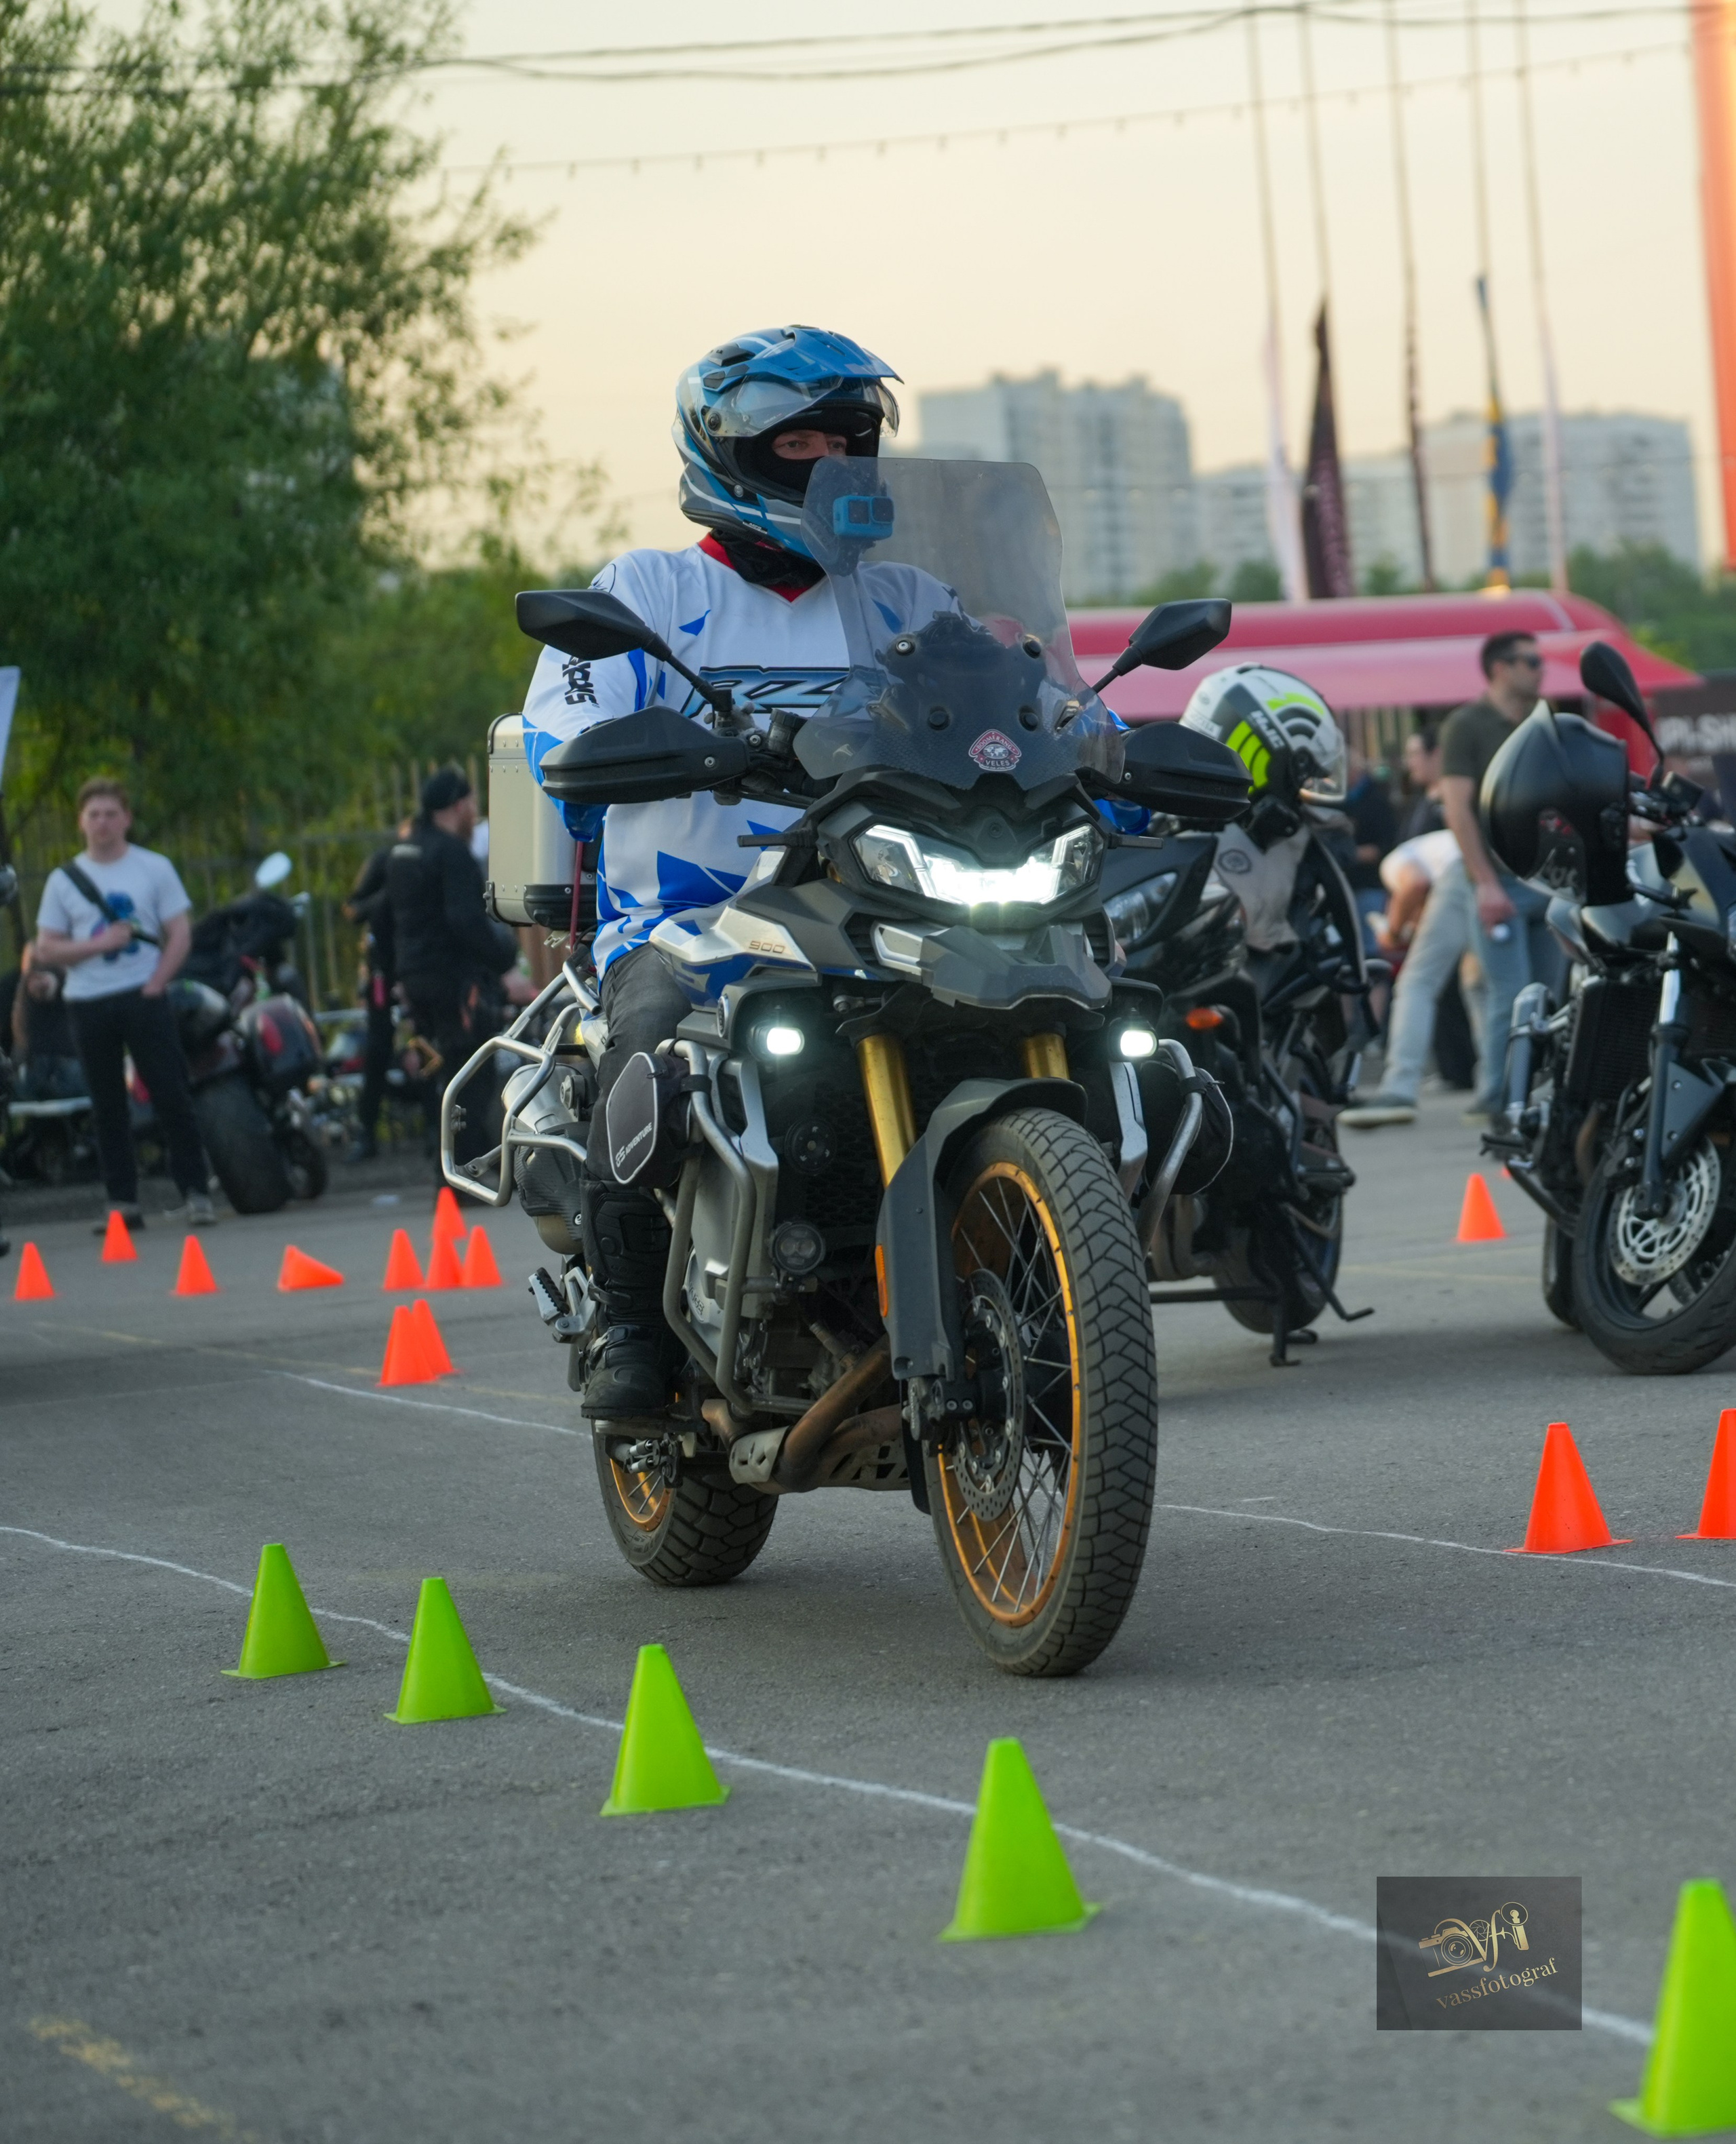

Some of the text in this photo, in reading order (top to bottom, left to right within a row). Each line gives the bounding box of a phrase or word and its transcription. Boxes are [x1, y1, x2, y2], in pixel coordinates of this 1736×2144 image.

[1250, 711, 1286, 749] HJC
[976, 735, 1013, 750] BOOMERANG
[749, 941, 786, 954] 900
[625, 1122, 653, 1156] ADVENTURE
